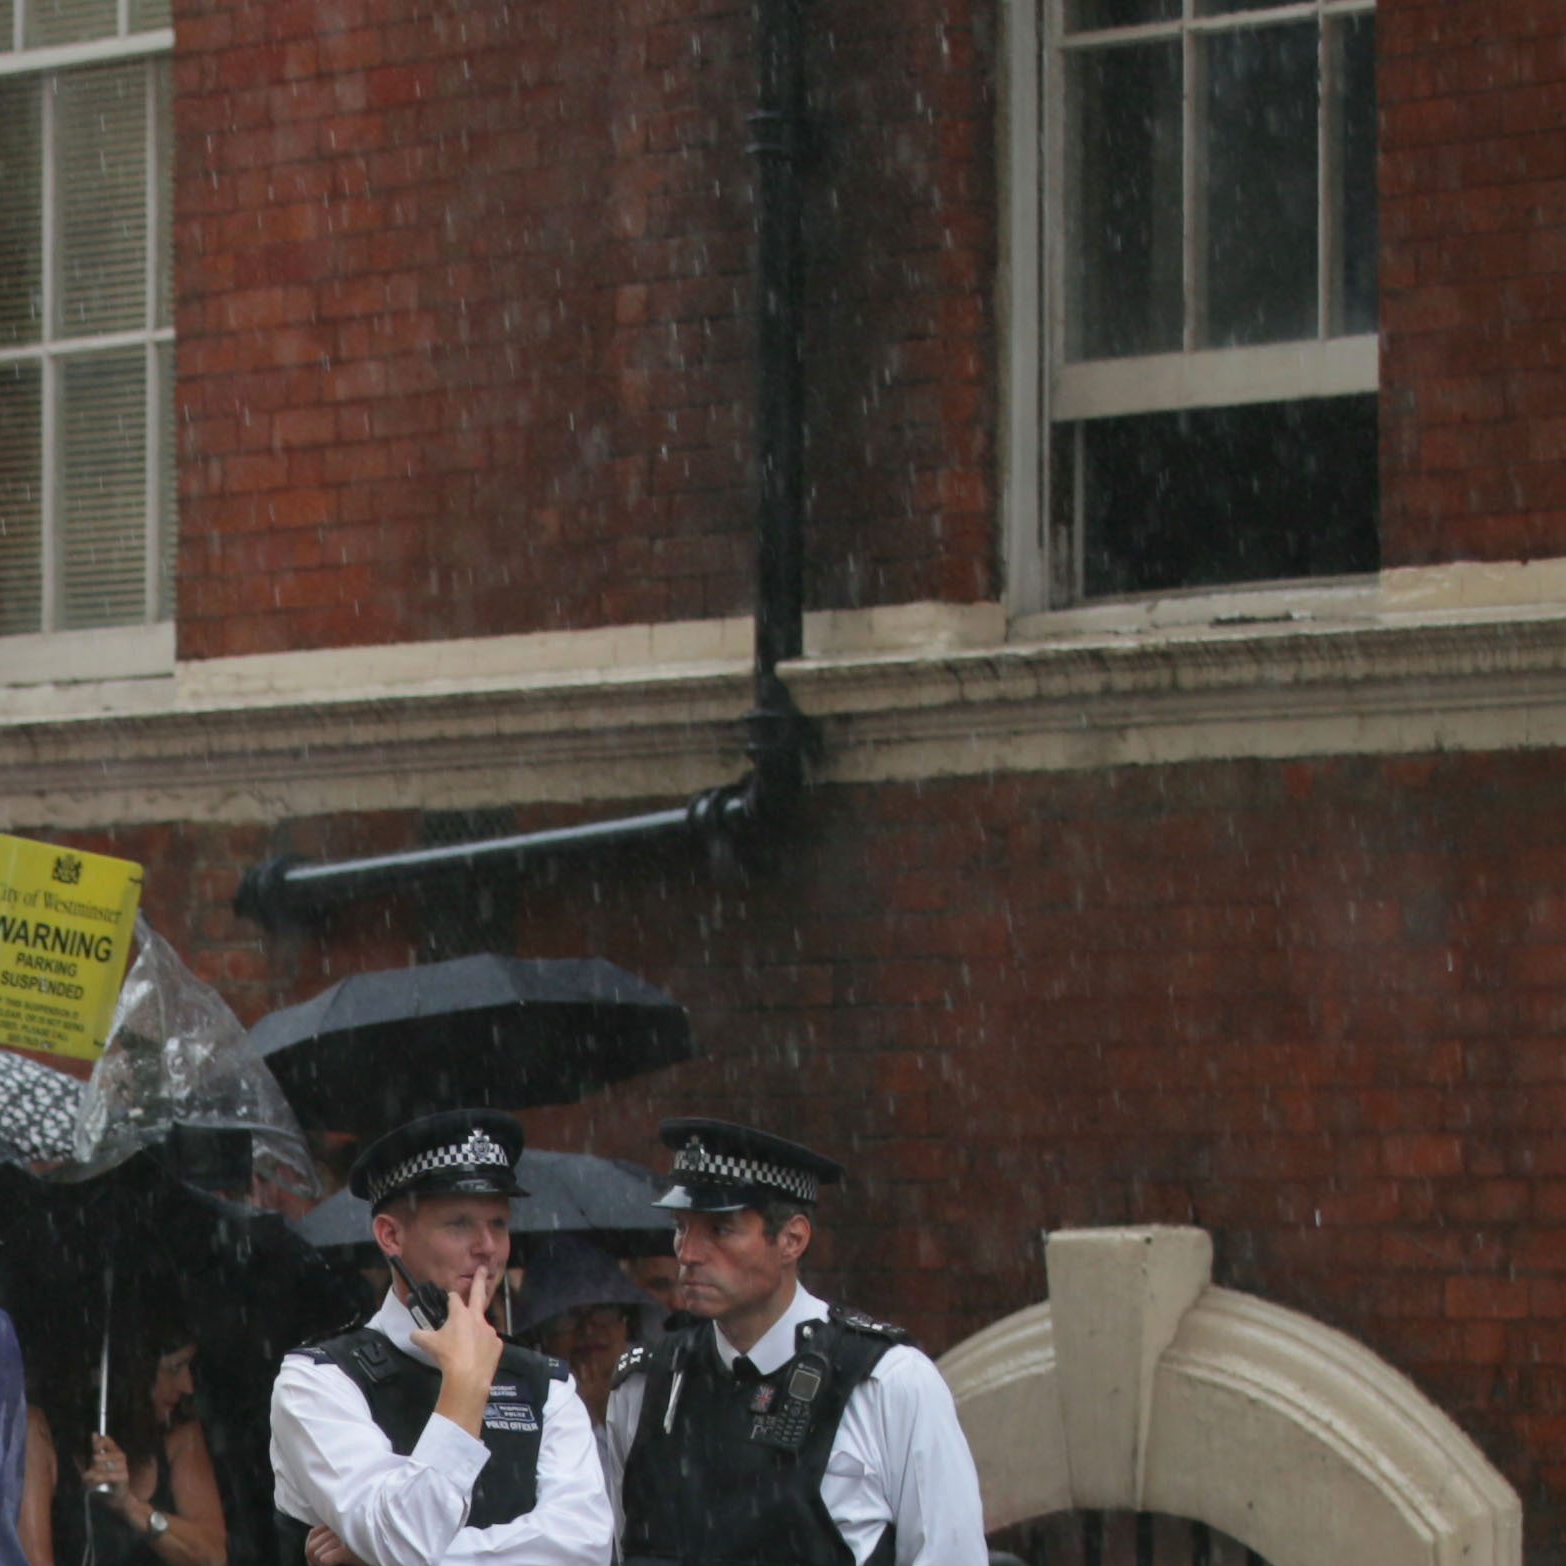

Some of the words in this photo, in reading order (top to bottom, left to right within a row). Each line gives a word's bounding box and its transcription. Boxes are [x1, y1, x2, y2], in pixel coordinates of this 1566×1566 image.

[23, 888, 39, 908] of
[43, 889, 123, 924] Westminster
[15, 952, 78, 978] PARKING
[0, 970, 84, 1000] SUSPENDED
[485, 1420, 510, 1431] POLICE
